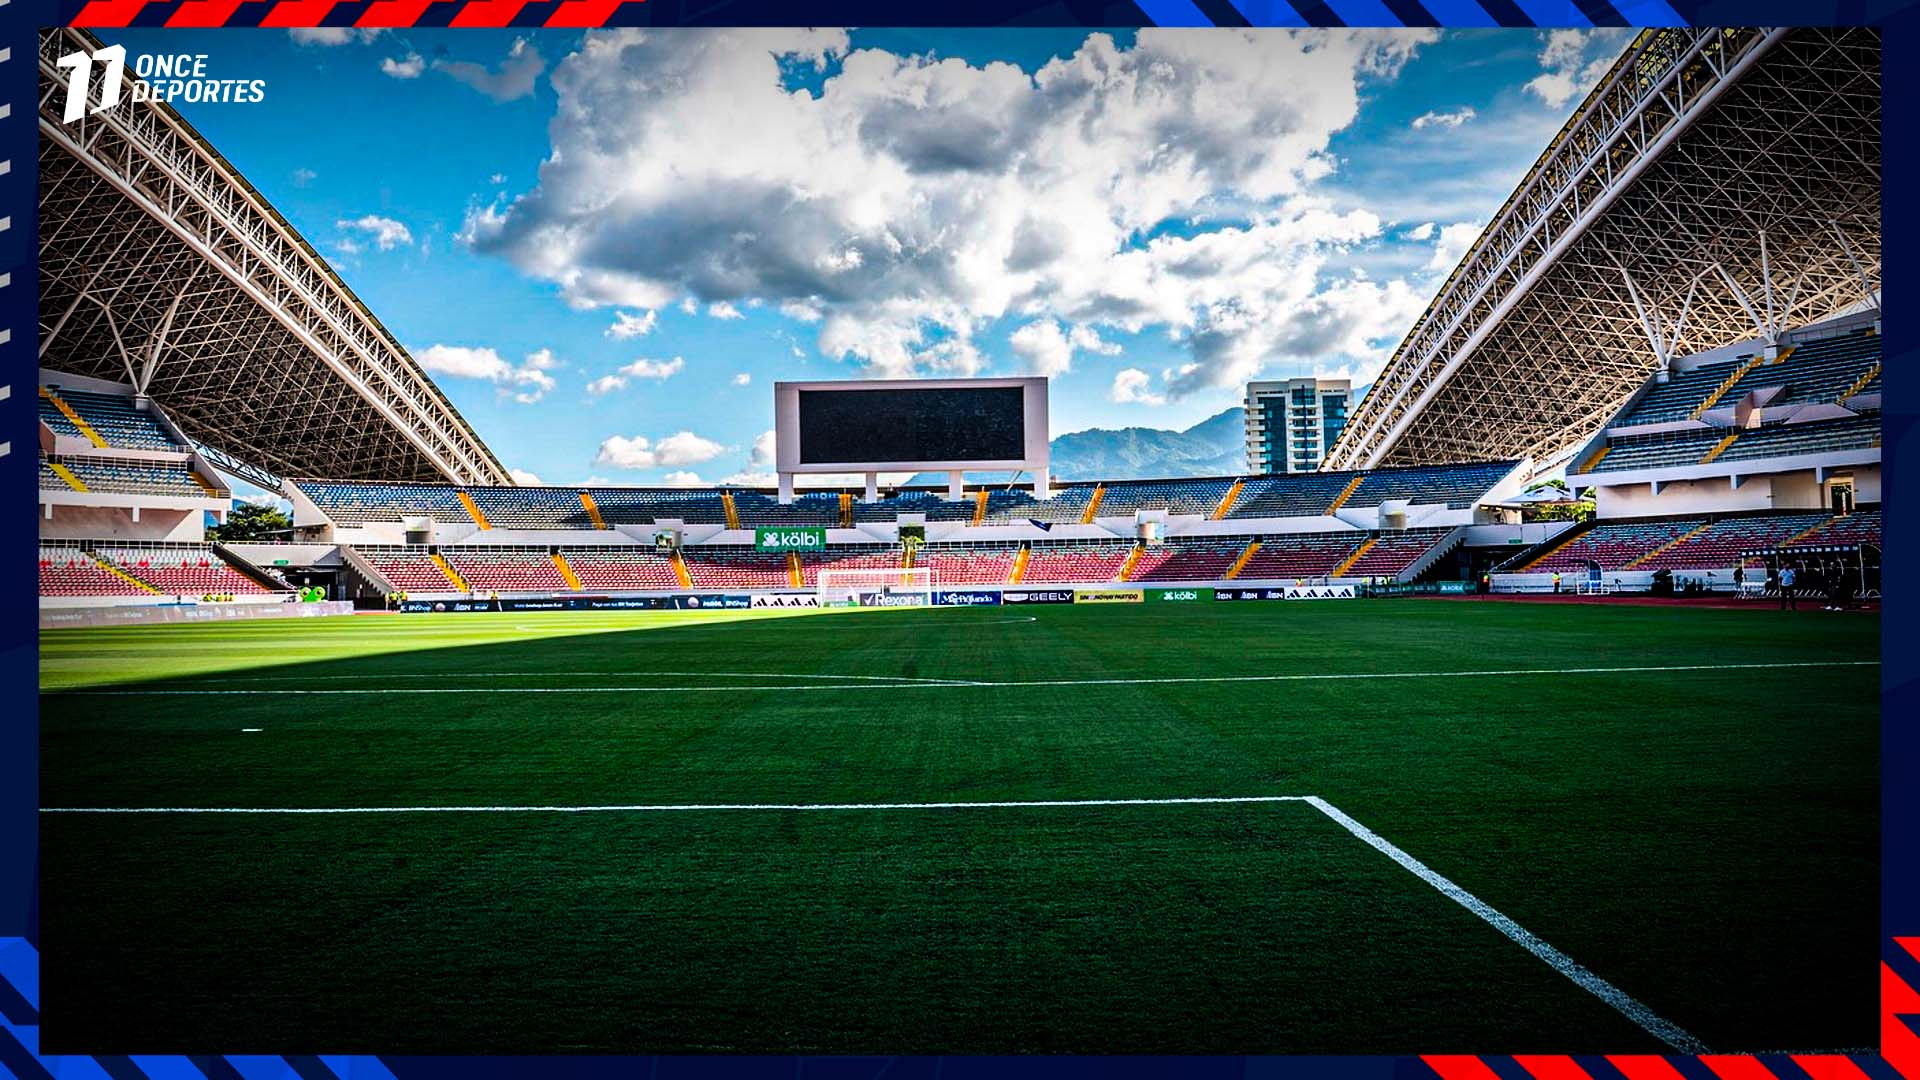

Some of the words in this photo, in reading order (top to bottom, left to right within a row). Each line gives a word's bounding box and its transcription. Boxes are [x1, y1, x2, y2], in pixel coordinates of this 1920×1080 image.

[781, 531, 820, 547] kölbi
[875, 593, 923, 606] Rexona
[1029, 592, 1073, 601] GEELY
[1174, 591, 1198, 600] kölbi
